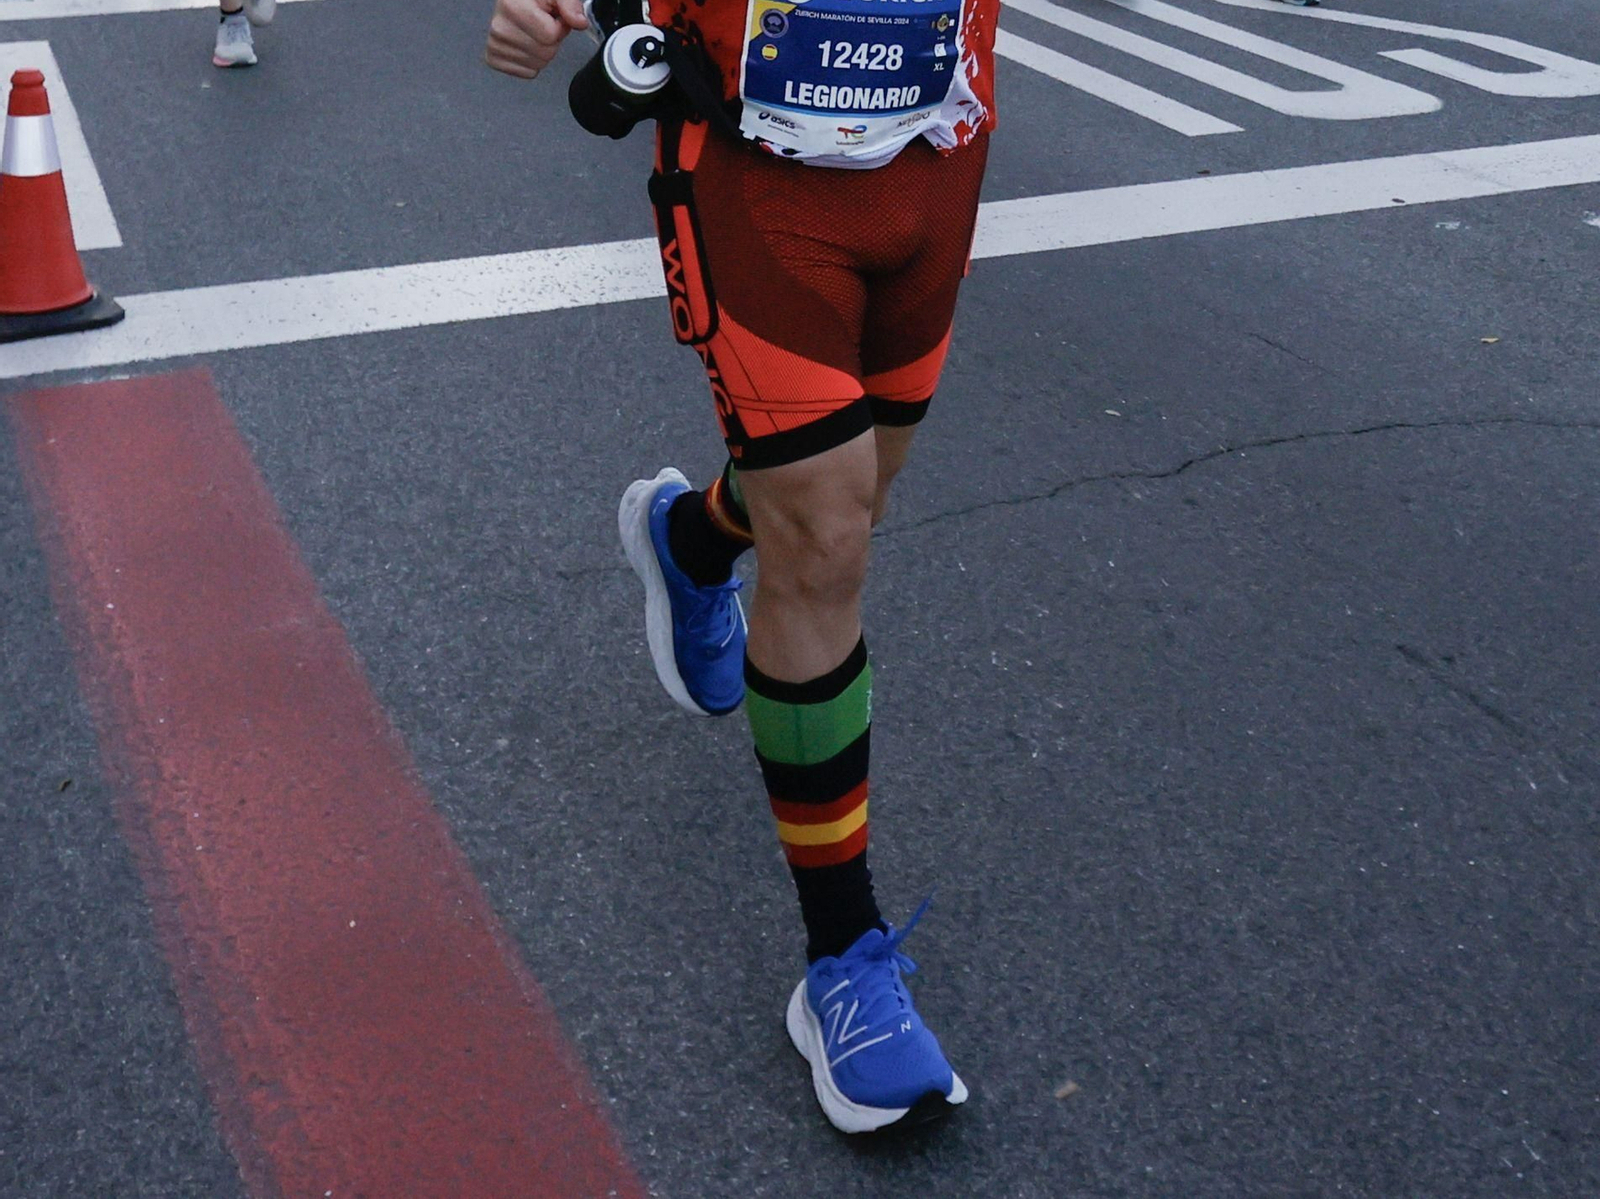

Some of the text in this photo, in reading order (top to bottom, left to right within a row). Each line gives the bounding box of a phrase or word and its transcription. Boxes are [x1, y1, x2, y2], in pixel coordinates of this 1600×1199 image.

[794, 8, 820, 19] ZURICH
[867, 16, 893, 25] SEVILLA
[818, 39, 904, 71] 12428
[784, 80, 921, 110] LEGIONARIO
